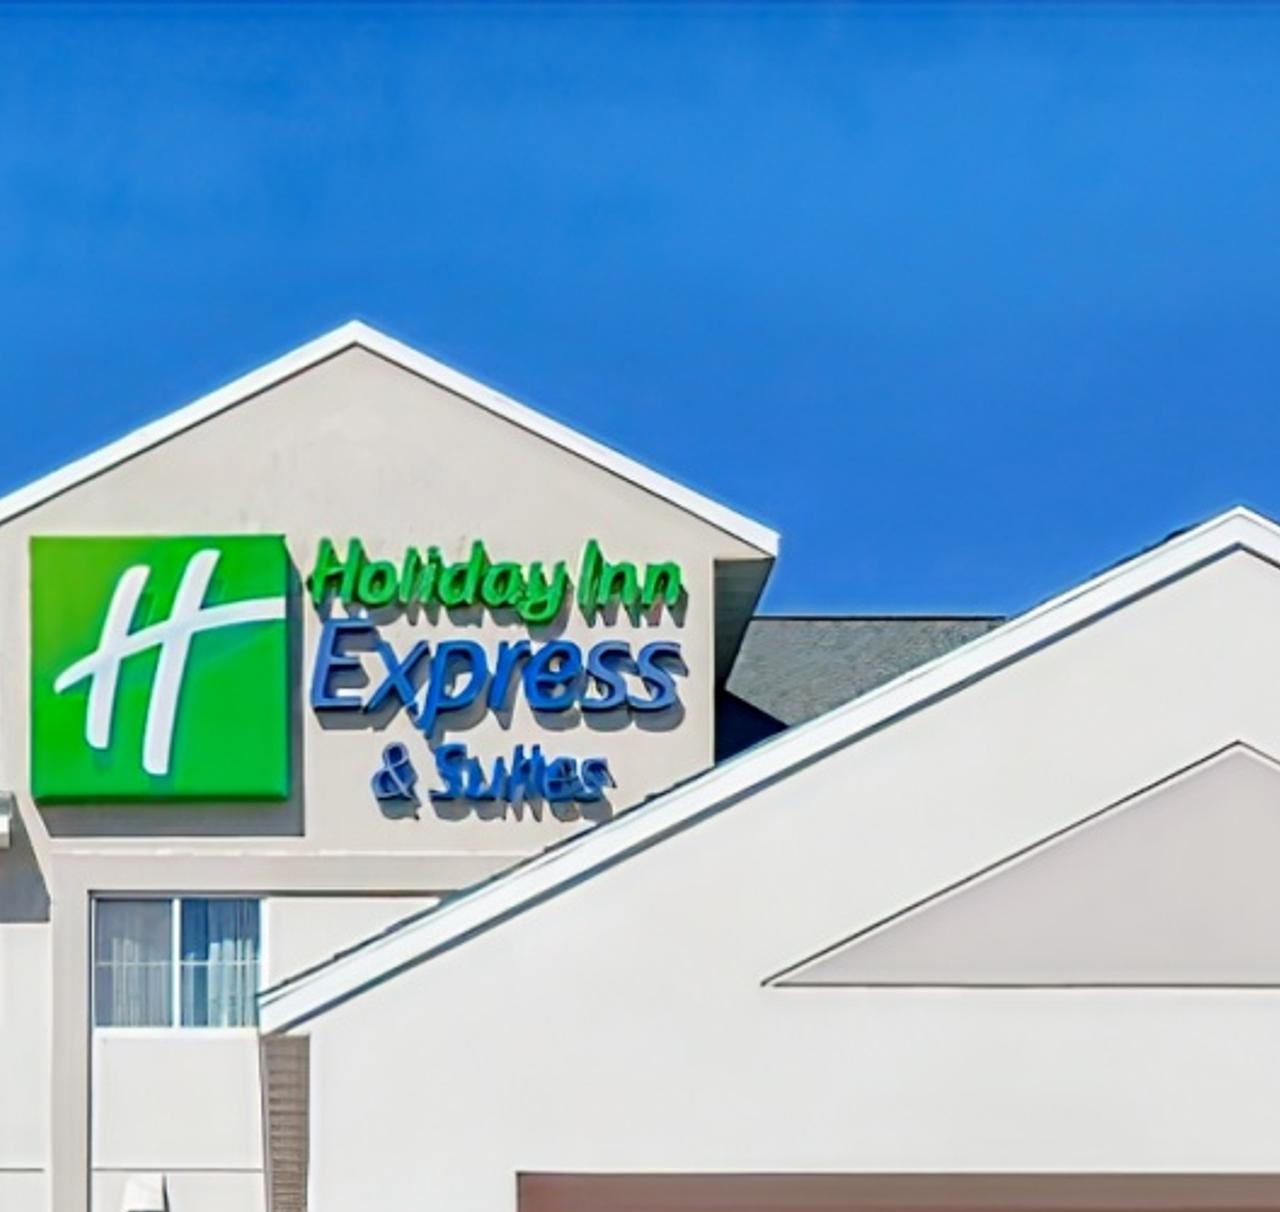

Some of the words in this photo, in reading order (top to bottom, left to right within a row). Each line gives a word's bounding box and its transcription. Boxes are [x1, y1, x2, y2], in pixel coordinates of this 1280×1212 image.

[307, 537, 570, 624] Holiday
[578, 539, 686, 611] Inn
[53, 549, 286, 775] H
[309, 617, 684, 740] Express
[371, 742, 418, 803] &
[430, 743, 616, 805] Suites
